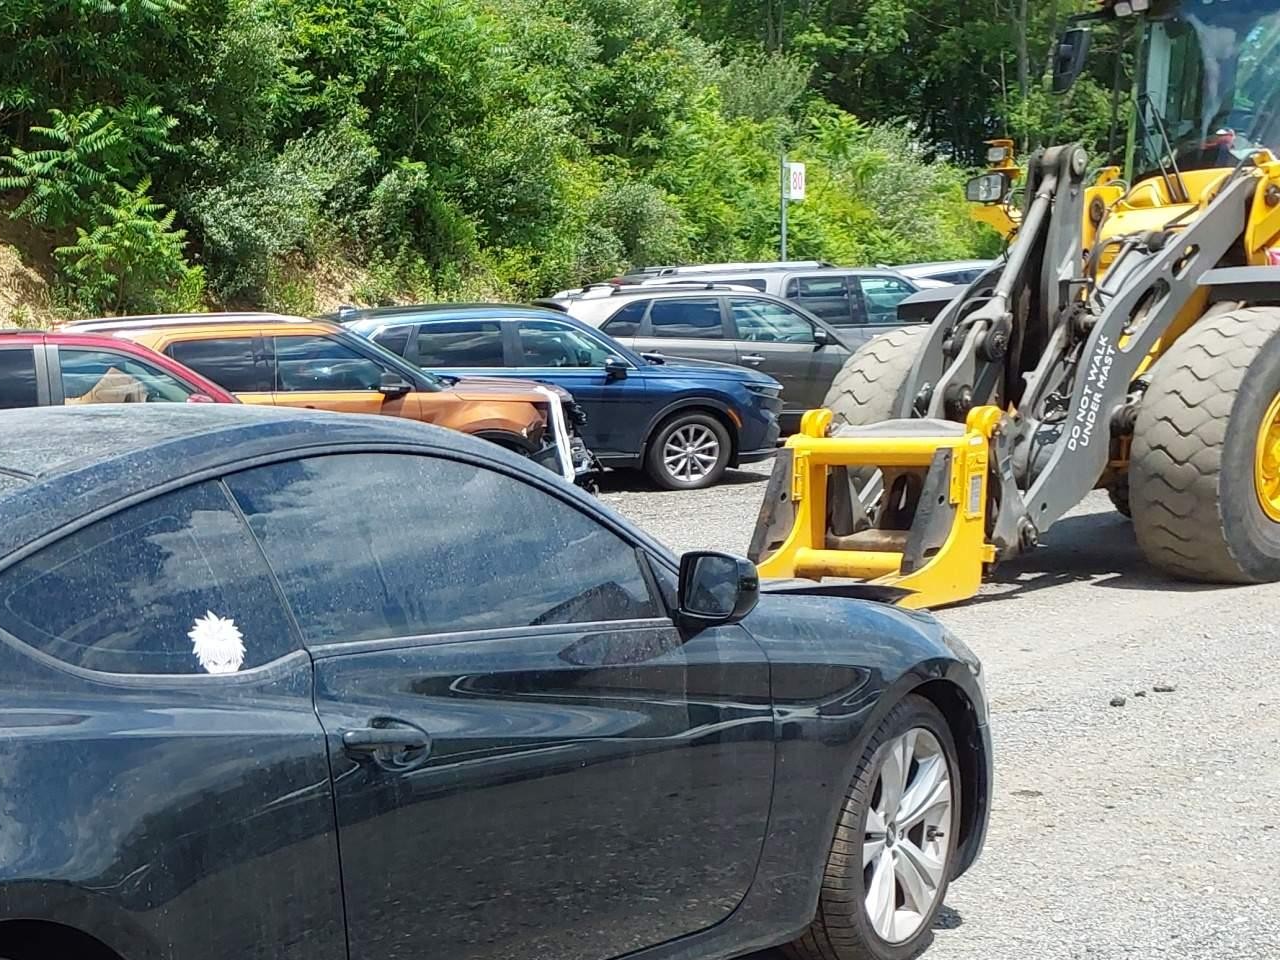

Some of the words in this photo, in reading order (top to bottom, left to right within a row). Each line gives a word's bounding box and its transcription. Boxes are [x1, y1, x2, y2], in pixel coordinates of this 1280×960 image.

[1067, 425, 1080, 451] DO
[1076, 384, 1093, 422] NOT
[1087, 334, 1108, 380] WALK
[1080, 392, 1102, 446] UNDER
[1097, 345, 1115, 389] MAST
